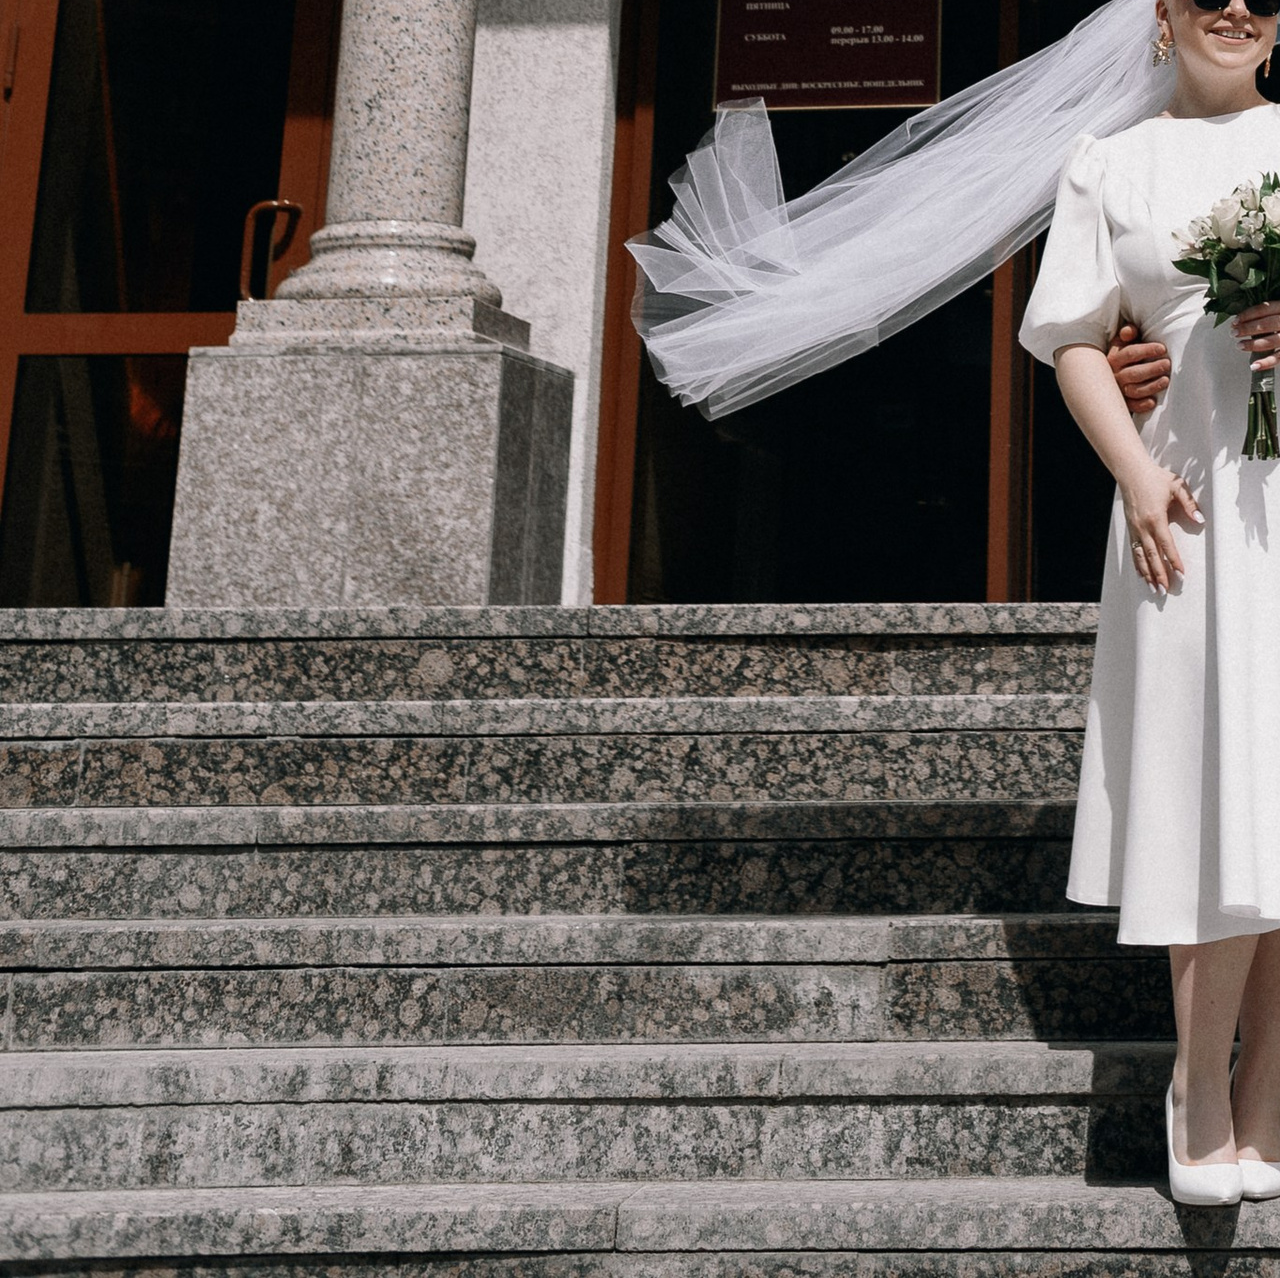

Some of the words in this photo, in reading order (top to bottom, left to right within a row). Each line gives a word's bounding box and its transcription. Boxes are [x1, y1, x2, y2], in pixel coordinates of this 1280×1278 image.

[745, 2, 791, 11] ПЯТНИЦА
[830, 26, 855, 34] 09.00
[861, 25, 885, 34] 17.00
[743, 33, 787, 42] СУББОТА
[830, 36, 870, 46] перерыв
[871, 35, 895, 43] 13.00
[901, 34, 925, 43] 14.00
